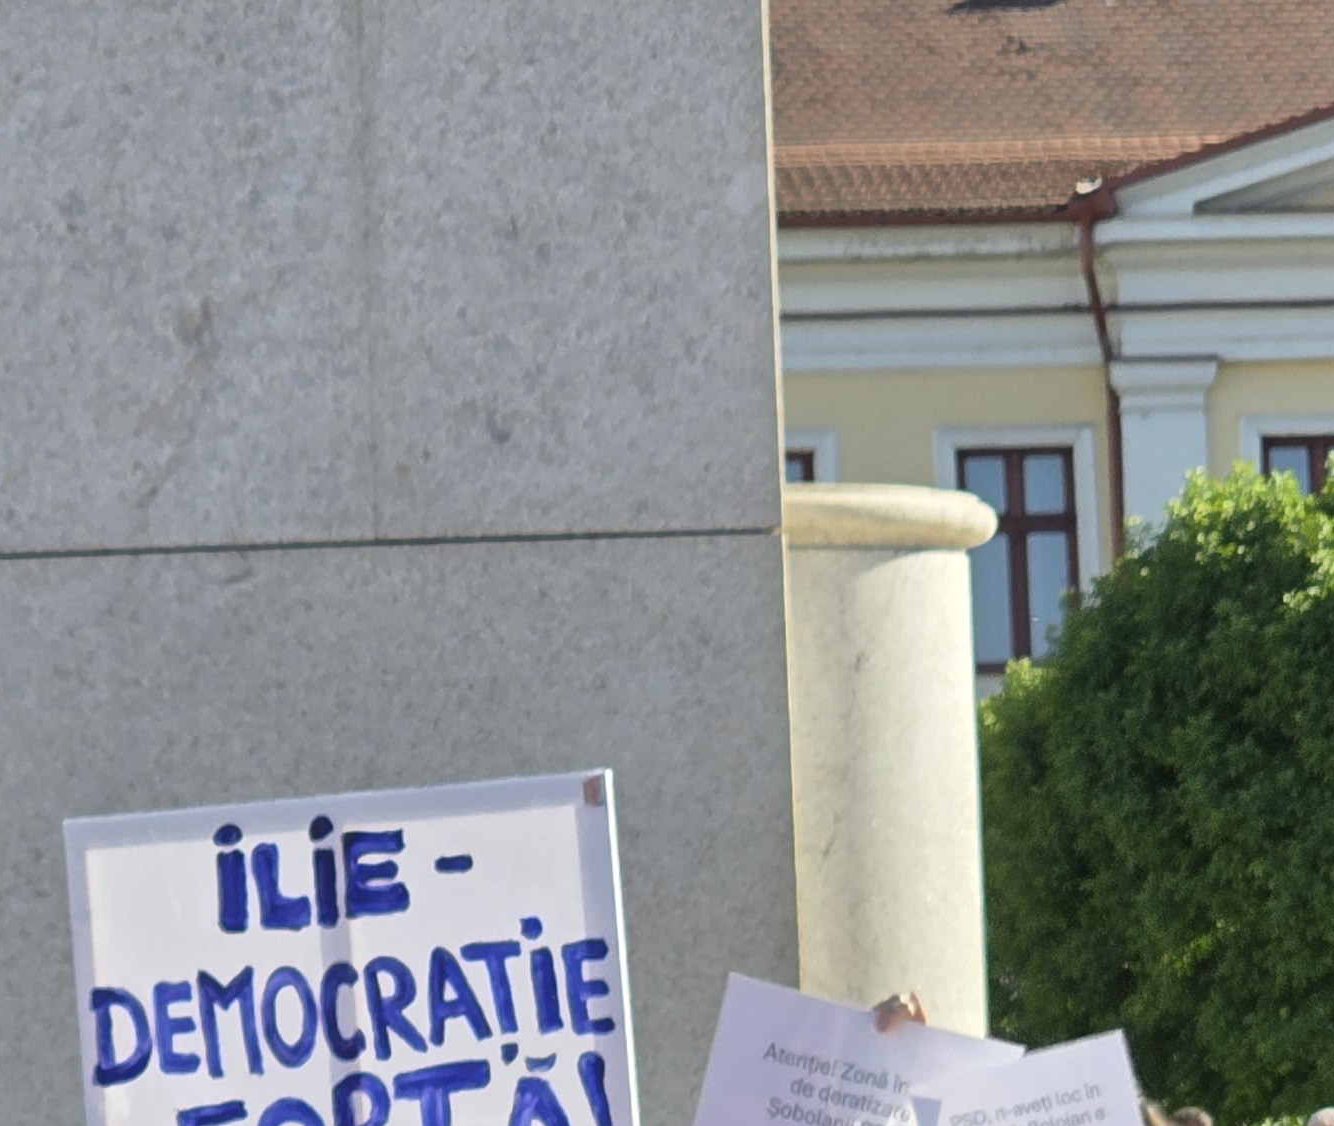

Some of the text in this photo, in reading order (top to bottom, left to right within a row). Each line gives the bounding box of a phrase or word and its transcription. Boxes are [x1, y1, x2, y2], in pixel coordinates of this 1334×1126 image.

[763, 1042, 837, 1077] Atenție!
[840, 1062, 889, 1090] Zonă
[789, 1078, 912, 1122] de deratizare
[1055, 1087, 1082, 1107] loc
[1083, 1082, 1101, 1100] în
[1094, 1107, 1106, 1121] e
